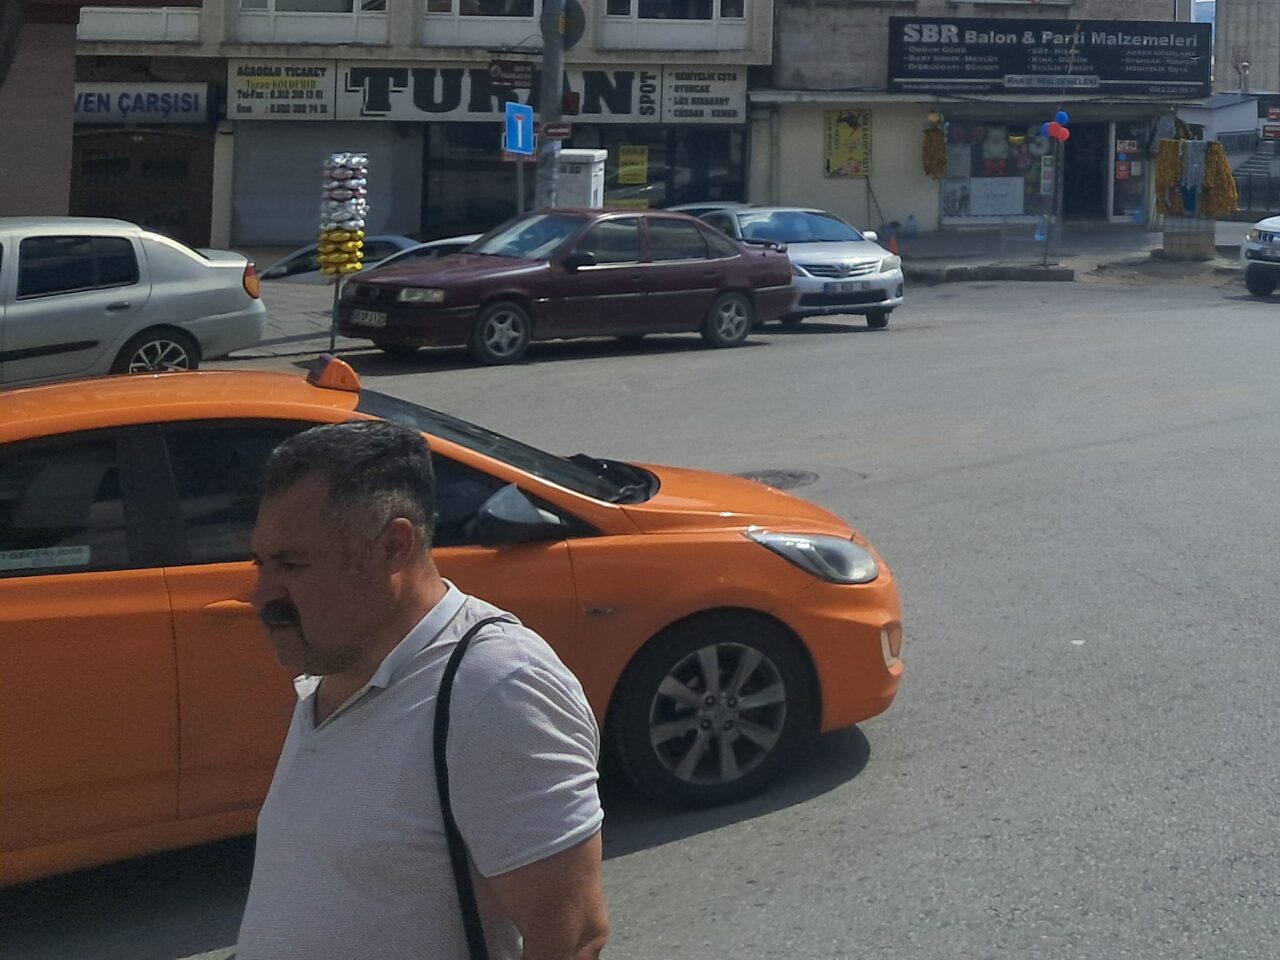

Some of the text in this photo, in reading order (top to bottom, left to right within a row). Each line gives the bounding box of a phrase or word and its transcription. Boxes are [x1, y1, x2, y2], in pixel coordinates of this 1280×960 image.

[903, 24, 1198, 47] SBR Balon & Parti Malzemeleri
[284, 64, 327, 77] TİCARET
[117, 92, 200, 118] ÇARŞISI
[639, 71, 657, 116] SPOT
